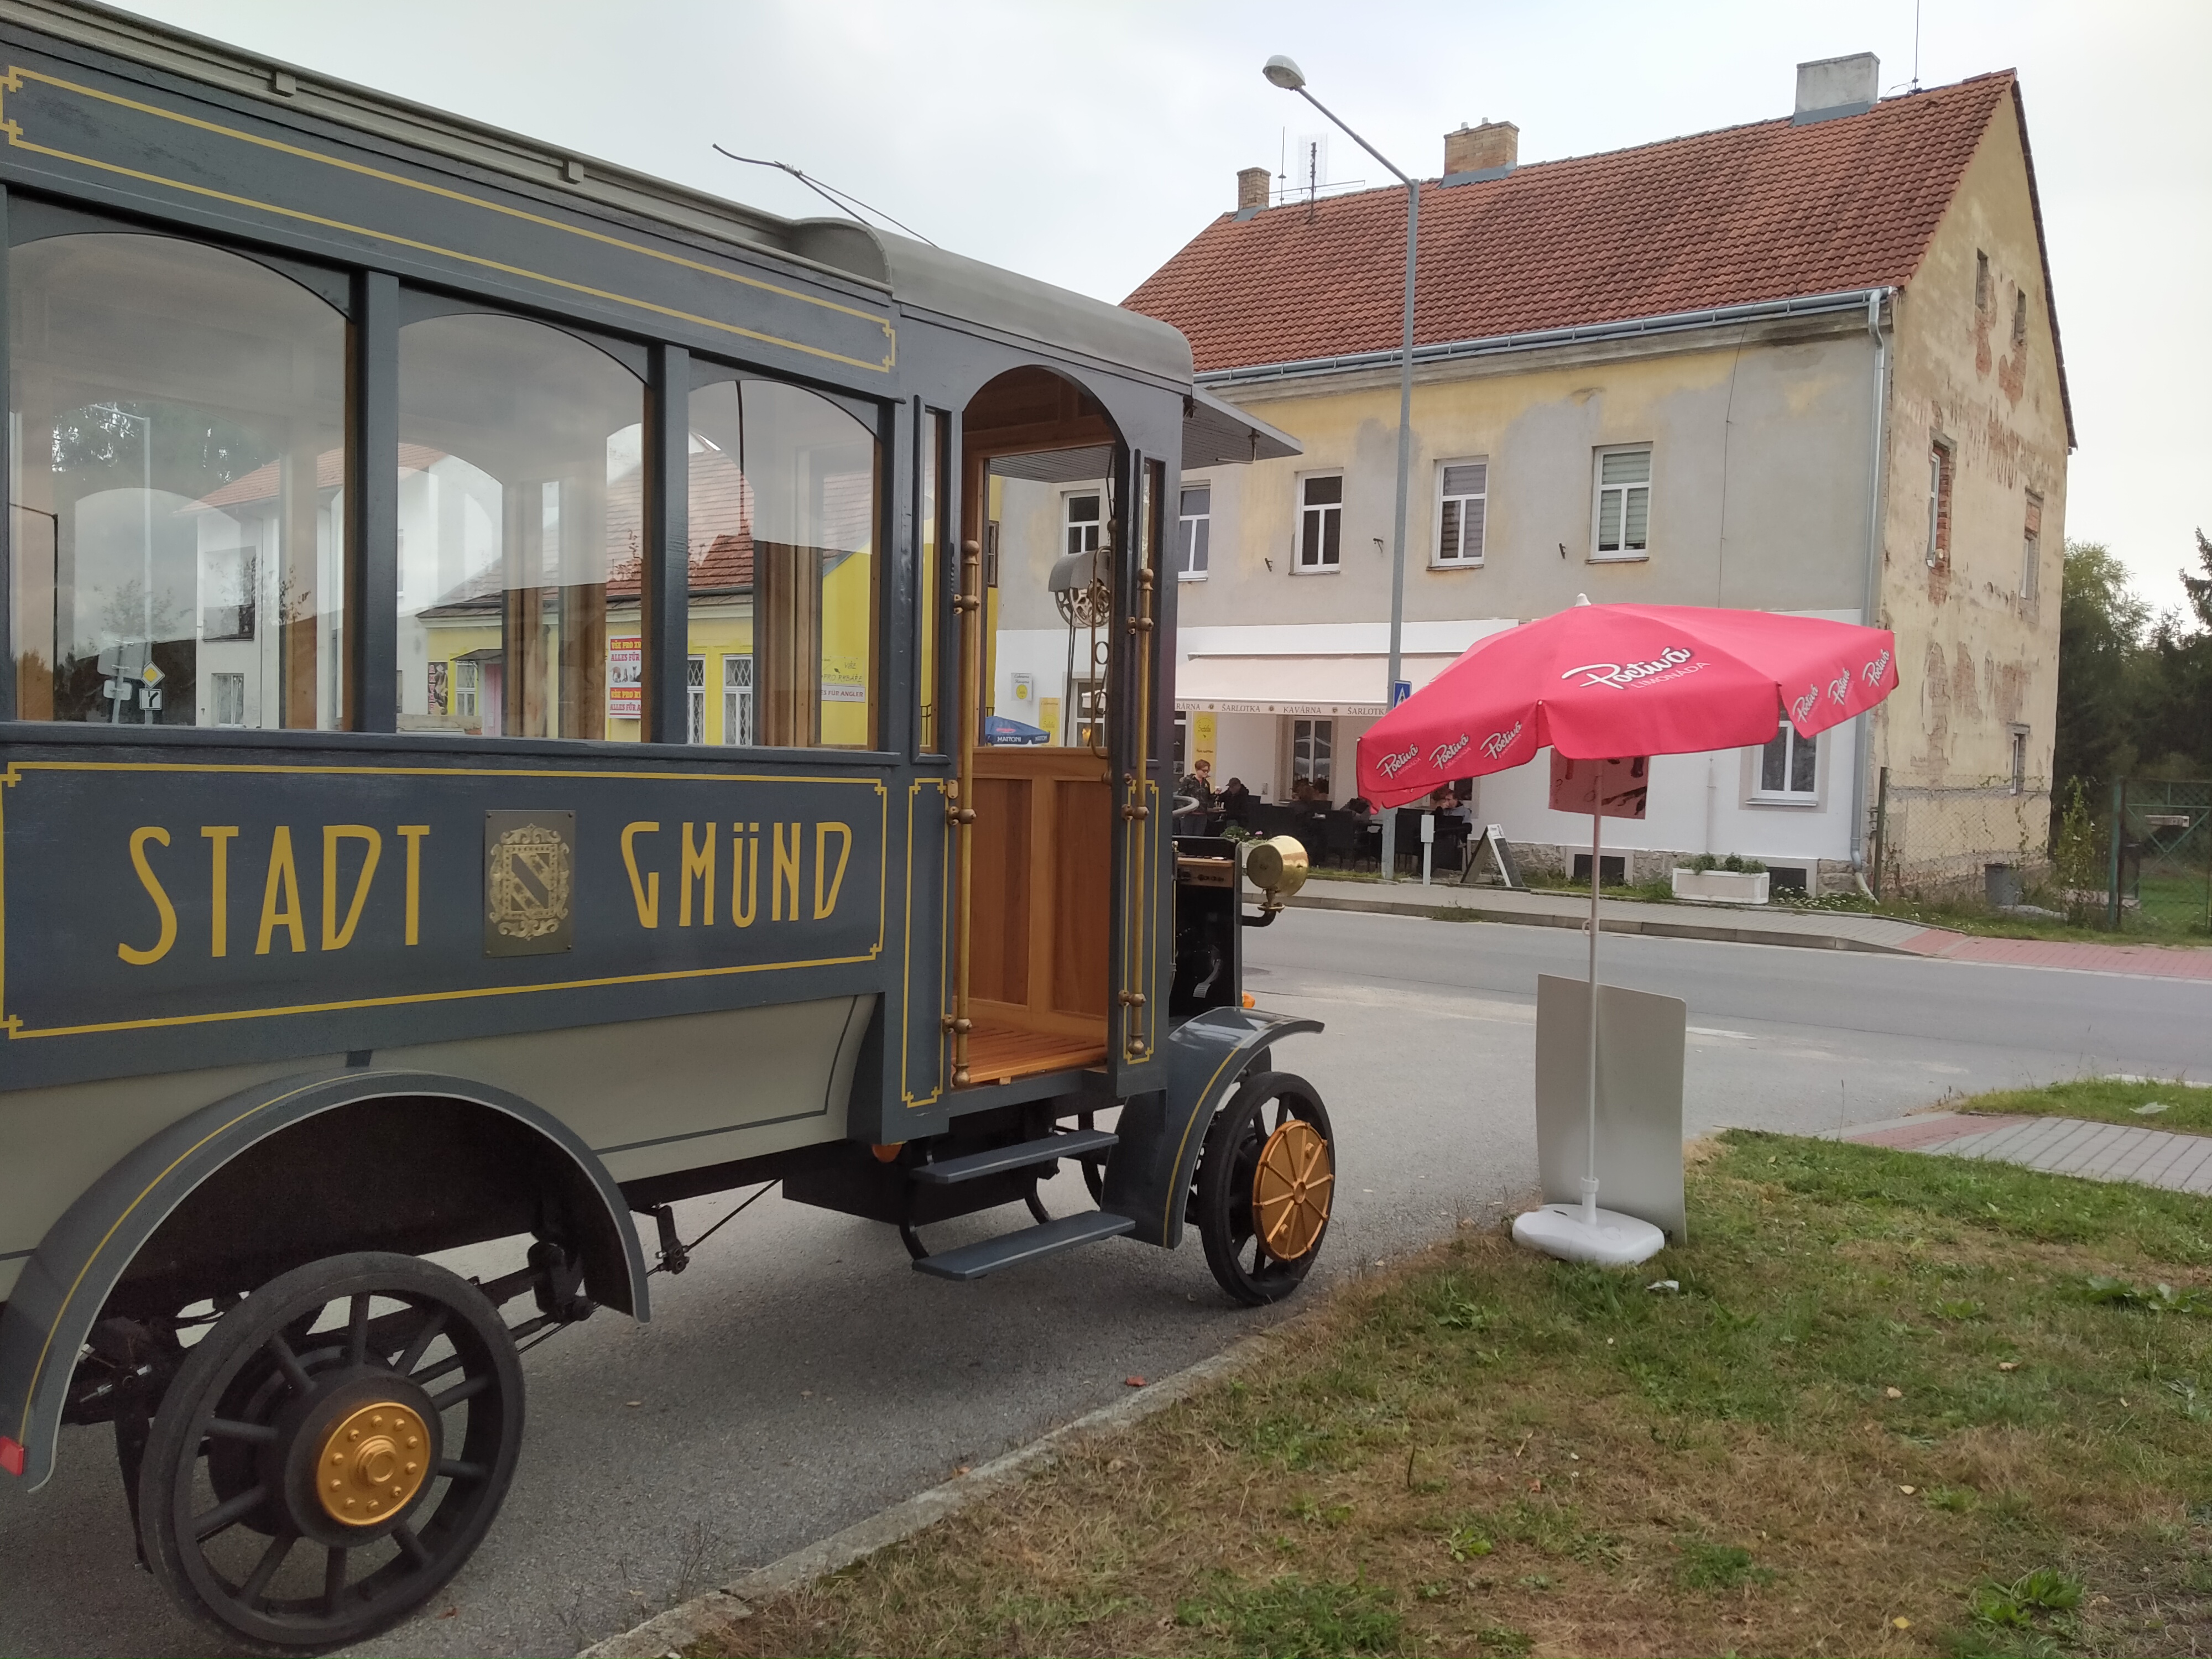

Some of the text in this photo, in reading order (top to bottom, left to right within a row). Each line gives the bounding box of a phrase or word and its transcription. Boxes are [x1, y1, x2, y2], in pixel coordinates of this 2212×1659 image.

[629, 651, 640, 661] FÜR
[1561, 647, 1691, 690] Poctivá
[1631, 662, 1711, 688] LIMONÁDA
[1222, 703, 1260, 712] ŠARLOTKA
[1284, 705, 1322, 714] KAVÁRNA
[1429, 733, 1469, 770] Poctivá
[1479, 721, 1522, 760] Poctivá
[1376, 744, 1418, 779] Poctivá
[118, 821, 852, 965] STADT GMÜND
